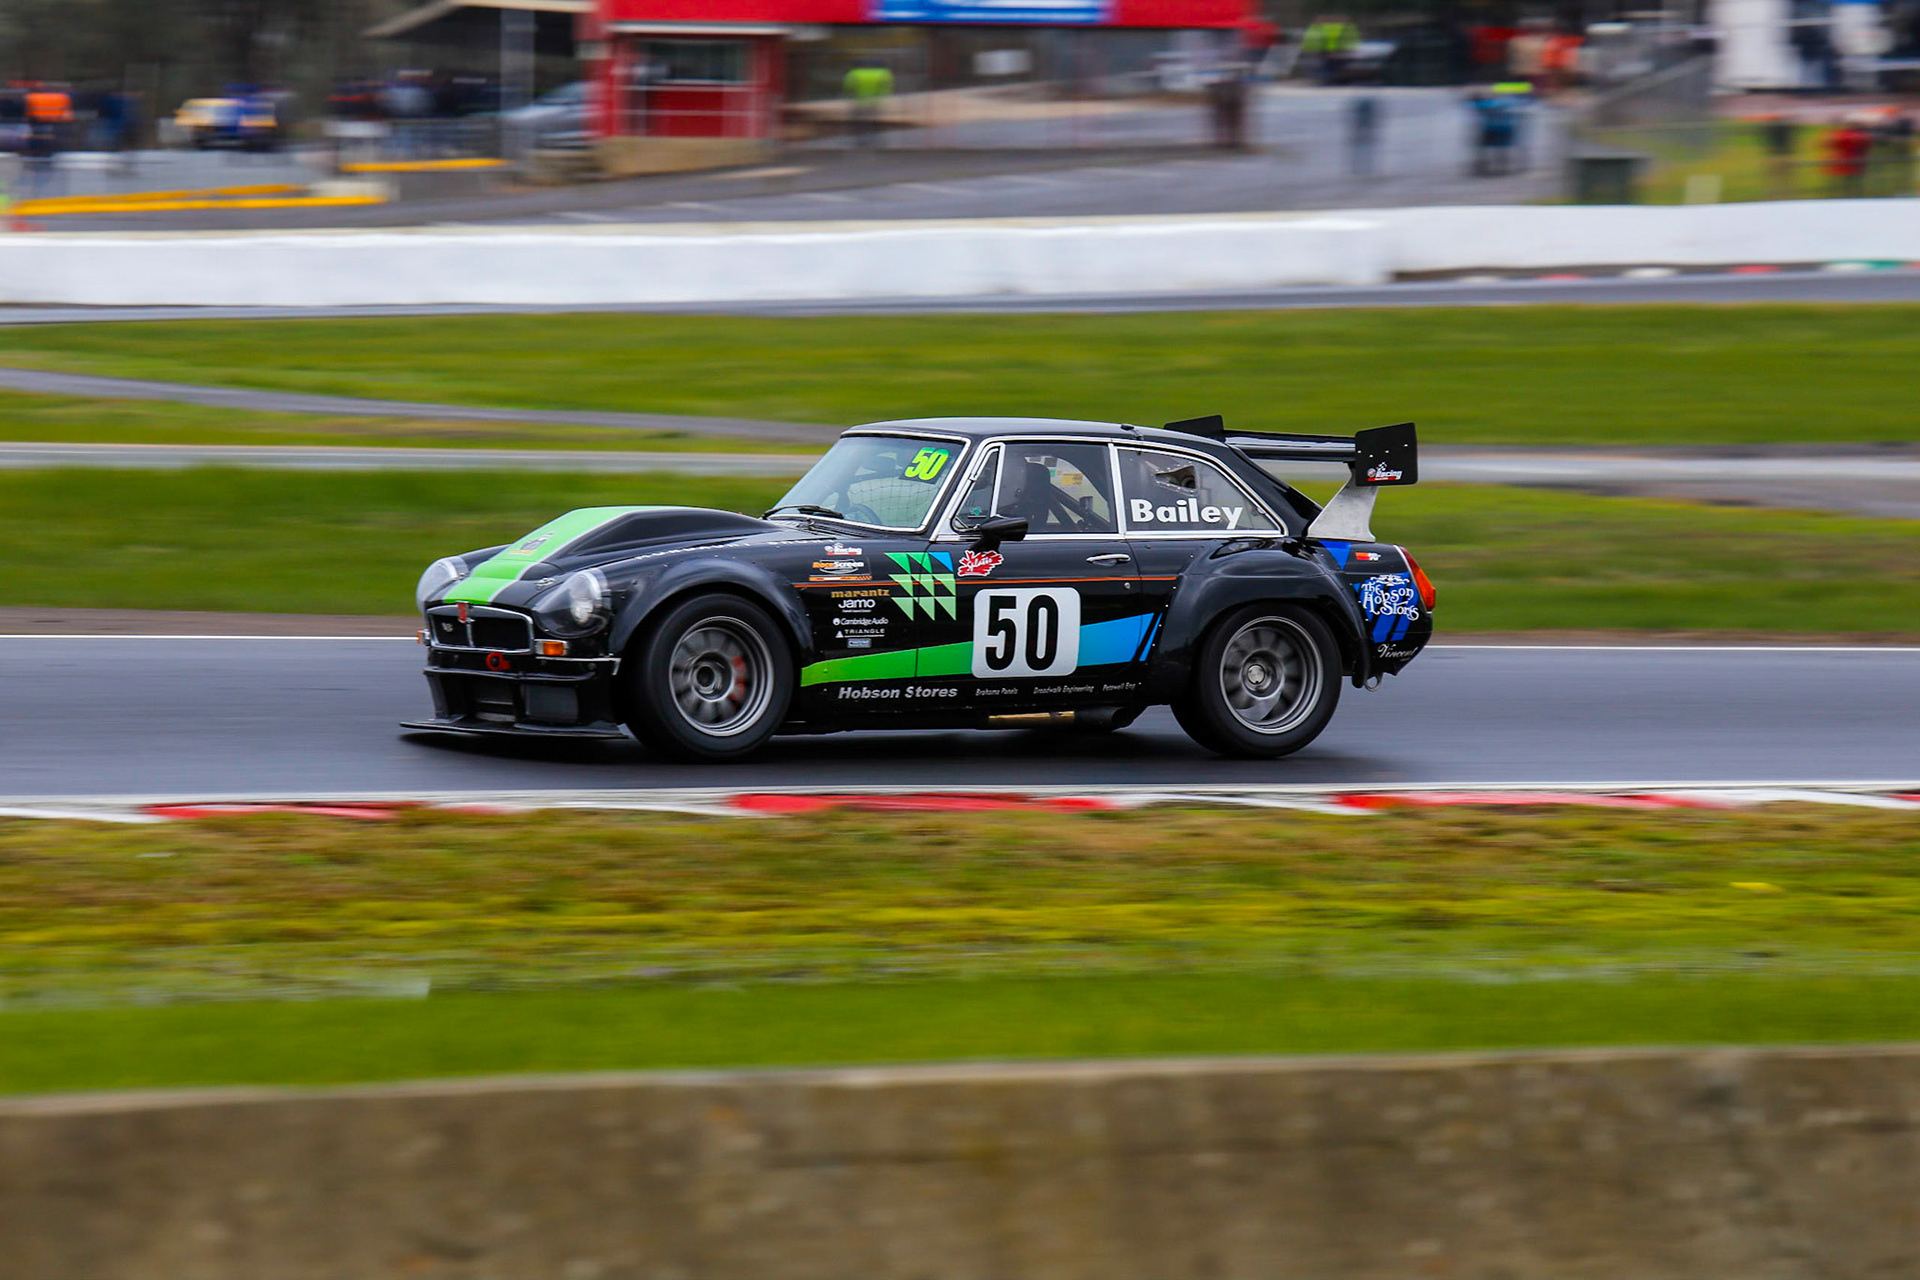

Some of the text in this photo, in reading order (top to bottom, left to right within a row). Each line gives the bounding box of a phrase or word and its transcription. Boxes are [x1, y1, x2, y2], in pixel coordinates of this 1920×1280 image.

[905, 447, 950, 480] 50
[1130, 498, 1243, 530] Bailey
[831, 589, 891, 598] marantz
[1362, 587, 1415, 615] Hobson
[985, 595, 1059, 671] 50
[838, 686, 958, 699] Hobson Stores
